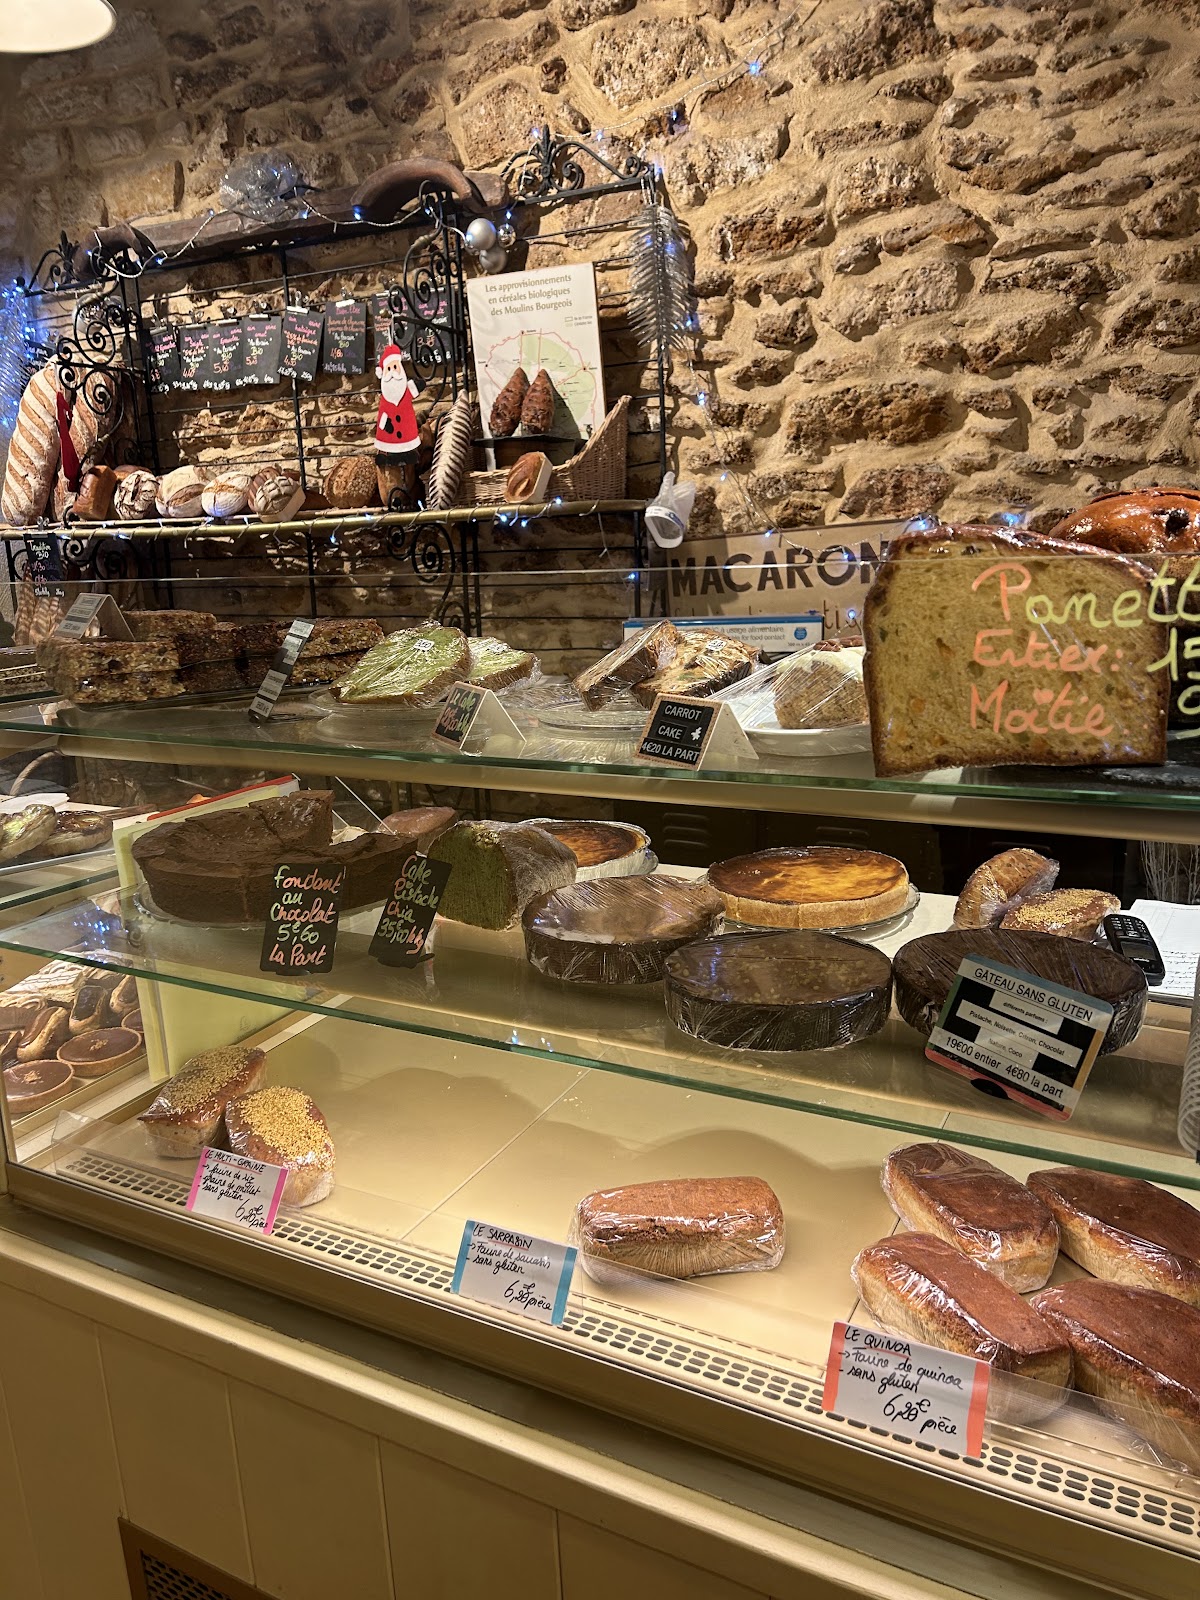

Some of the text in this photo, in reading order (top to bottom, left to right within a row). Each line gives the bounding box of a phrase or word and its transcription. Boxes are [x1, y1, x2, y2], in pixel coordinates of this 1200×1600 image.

[485, 274, 572, 292] Les approvisionnements
[499, 292, 527, 303] céréales
[528, 287, 570, 299] biologiques
[491, 298, 573, 316] des Moulins Bourgeois
[748, 625, 784, 633] alimentaire
[664, 704, 702, 721] CARROT
[658, 725, 683, 740] CAKE
[641, 741, 700, 762] 4€20 LA PART
[282, 891, 304, 905] au
[270, 897, 337, 924] Chocolat
[974, 968, 1093, 1022] GÂTEAU SANS GLUTEN
[1008, 1047, 1023, 1058] Coco
[1038, 1040, 1065, 1056] Chocolat
[946, 1036, 1064, 1099] 19€00 entier 4€80 la part
[204, 1149, 214, 1159] LE
[472, 1223, 485, 1237] LE
[502, 1247, 513, 1260] de
[472, 1255, 525, 1275] sans gluten
[844, 1324, 861, 1343] LE
[846, 1365, 920, 1394] sans gluten
[894, 1357, 912, 1374] de
[916, 1366, 964, 1391] quinoa
